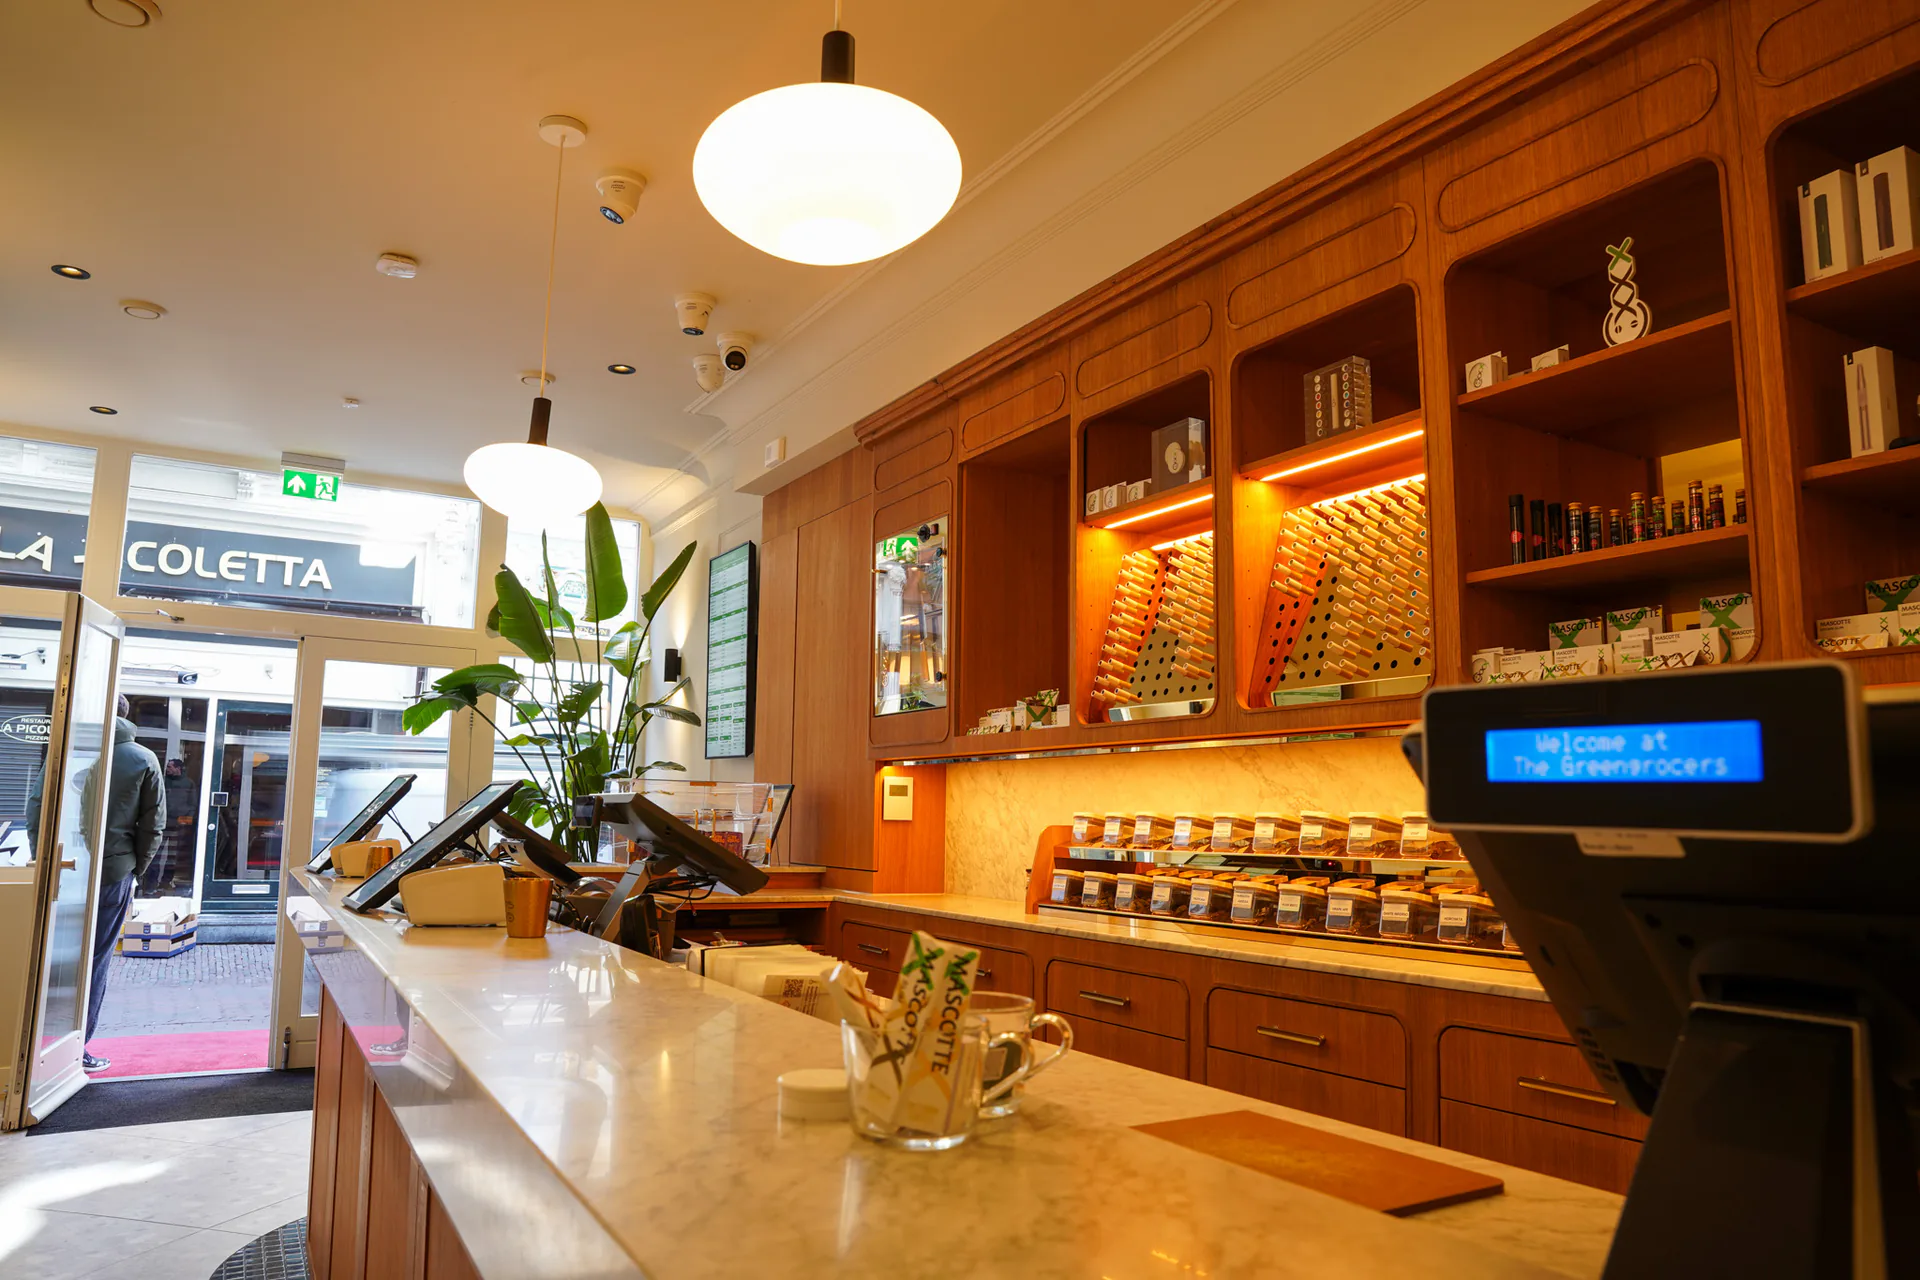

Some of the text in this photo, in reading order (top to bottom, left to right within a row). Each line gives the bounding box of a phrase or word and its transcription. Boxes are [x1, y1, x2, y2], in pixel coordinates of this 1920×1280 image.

[1868, 578, 1920, 594] MASCO
[1608, 609, 1660, 624] MASCOTTE
[1820, 619, 1851, 627] MASCOTTE
[1550, 620, 1600, 634] MASCOTTE
[1654, 633, 1681, 641] MASCOTTE
[1817, 637, 1860, 648] ASCOTTE
[1535, 730, 1668, 754] Welcome at
[1514, 755, 1550, 776] The
[931, 954, 968, 1075] MASCOTTE
